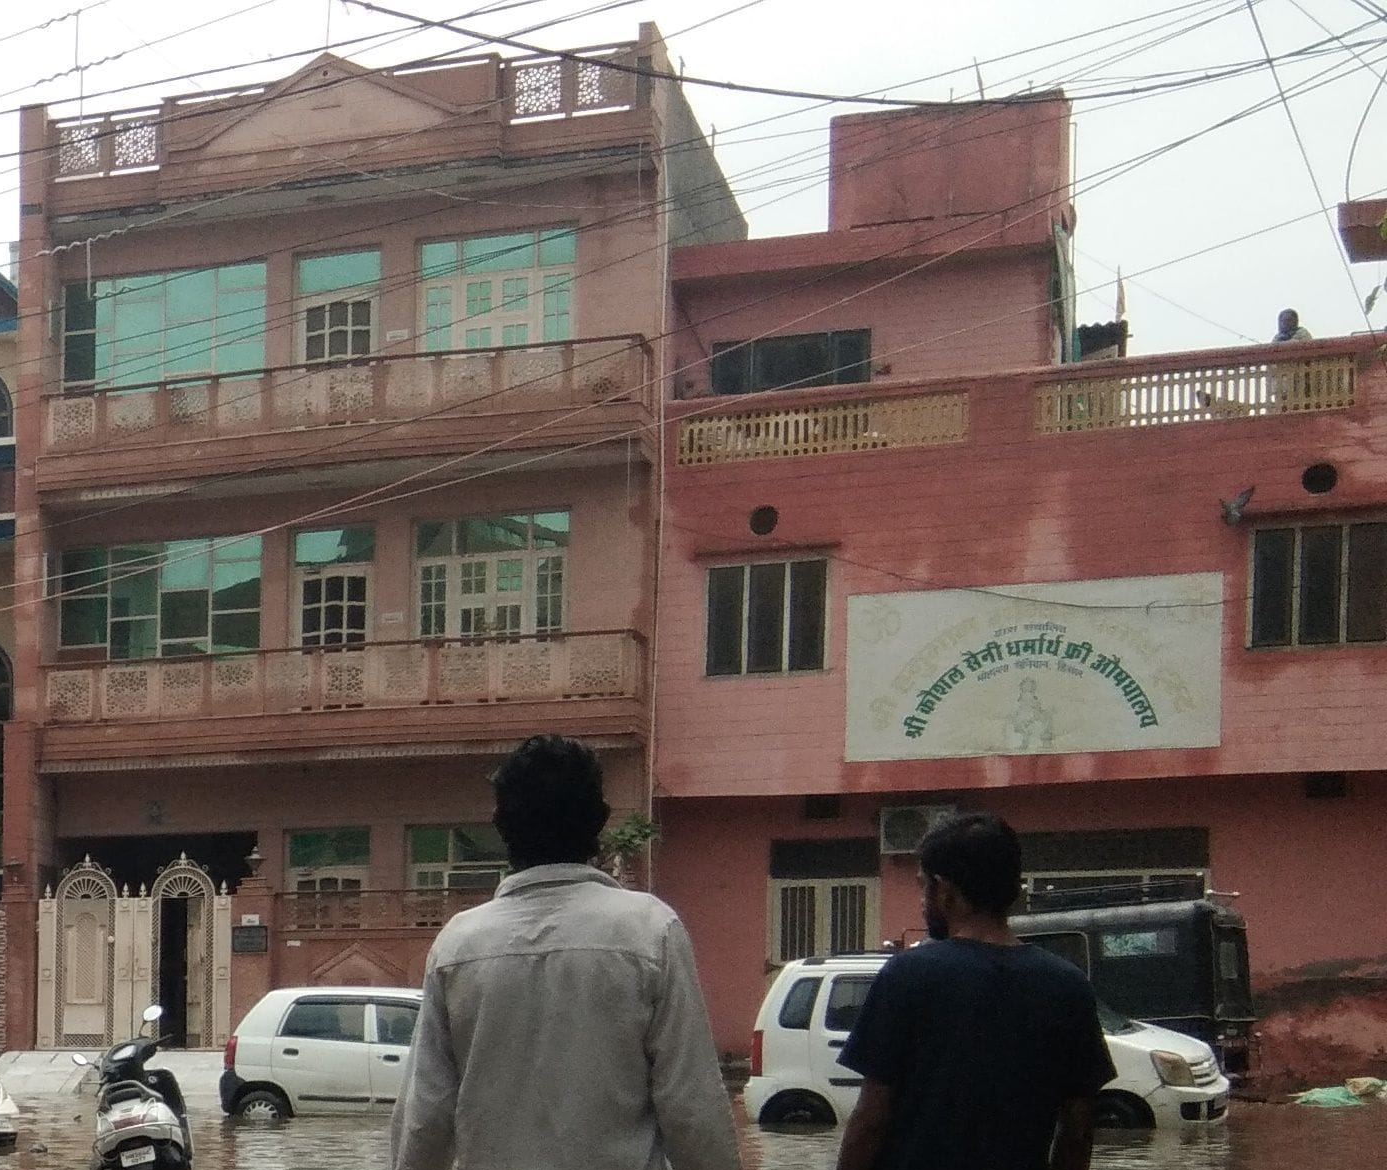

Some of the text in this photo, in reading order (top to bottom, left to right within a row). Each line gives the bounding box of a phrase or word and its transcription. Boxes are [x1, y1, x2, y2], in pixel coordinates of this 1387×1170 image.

[902, 714, 929, 739] श्री
[962, 641, 1004, 672] सैनी
[1006, 633, 1064, 656] धर्मार्थ
[1062, 641, 1094, 664] फ्री
[1090, 653, 1159, 728] औषधालय
